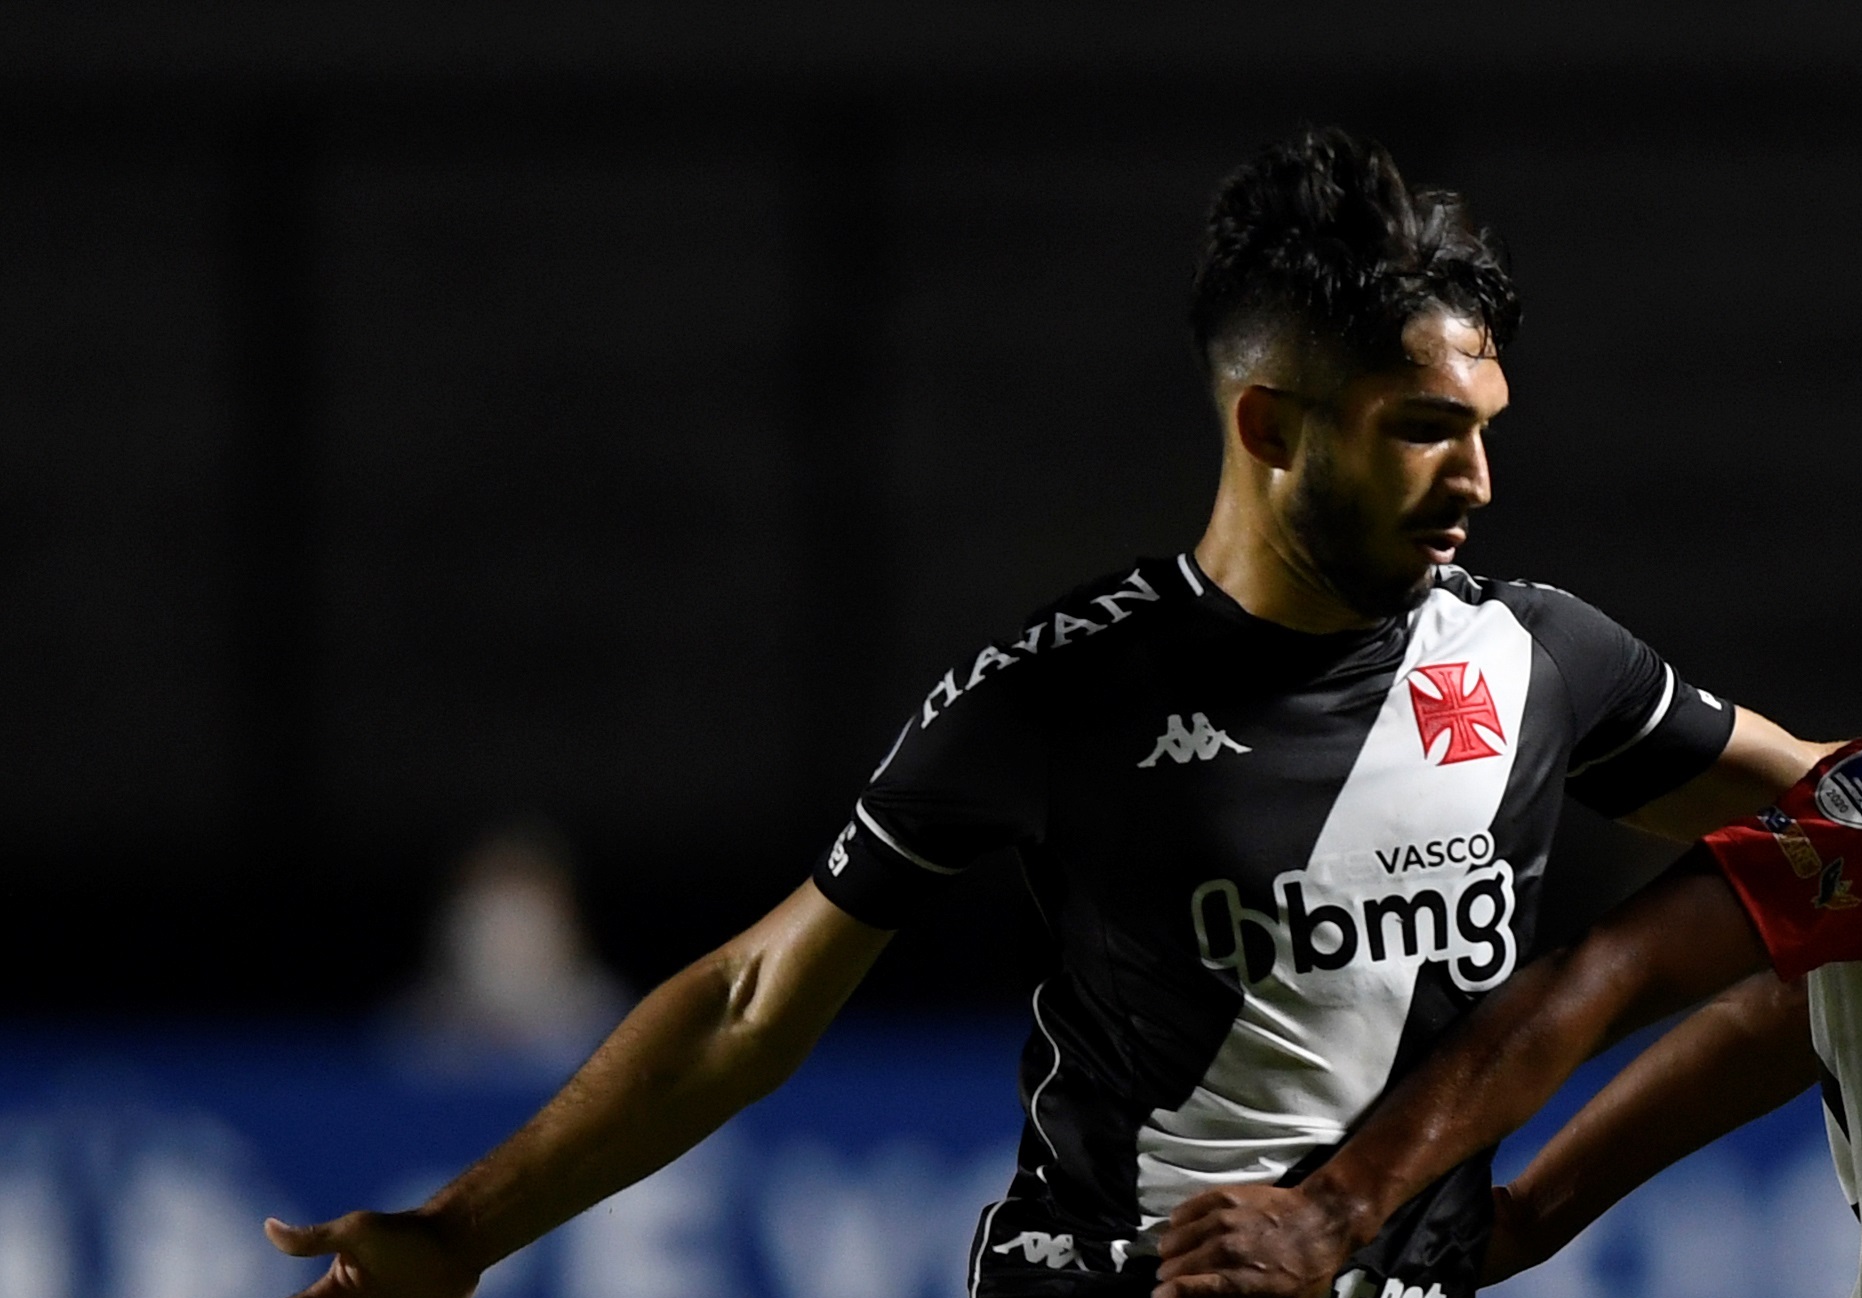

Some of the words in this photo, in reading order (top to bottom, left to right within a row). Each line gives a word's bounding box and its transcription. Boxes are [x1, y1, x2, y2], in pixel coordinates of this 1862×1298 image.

[1825, 788, 1849, 814] 2020
[1375, 834, 1489, 874] VASCO
[1283, 871, 1506, 983] bmg
